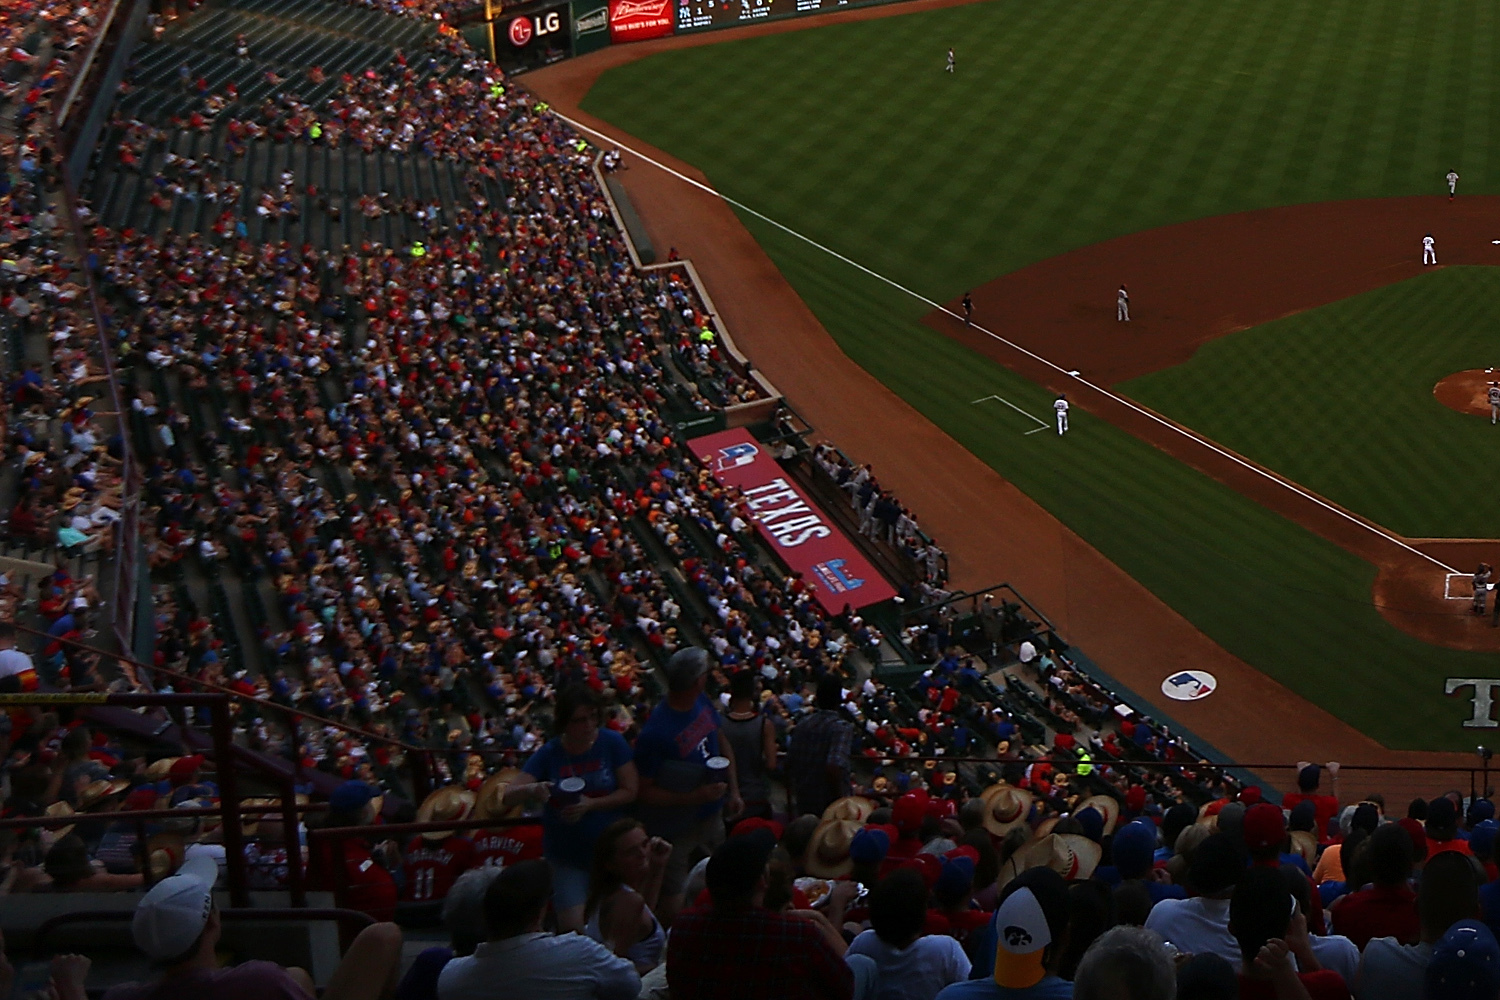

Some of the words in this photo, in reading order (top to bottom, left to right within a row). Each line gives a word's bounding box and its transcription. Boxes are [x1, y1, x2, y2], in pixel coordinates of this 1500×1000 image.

[617, 1, 665, 16] Budweiser
[697, 7, 703, 15] 1
[708, 0, 715, 8] 5
[534, 12, 561, 37] LG
[615, 23, 628, 32] THIS
[628, 21, 645, 30] BUD'S
[646, 20, 657, 28] FOR
[743, 476, 832, 548] TEXAS
[414, 866, 436, 900] 11
